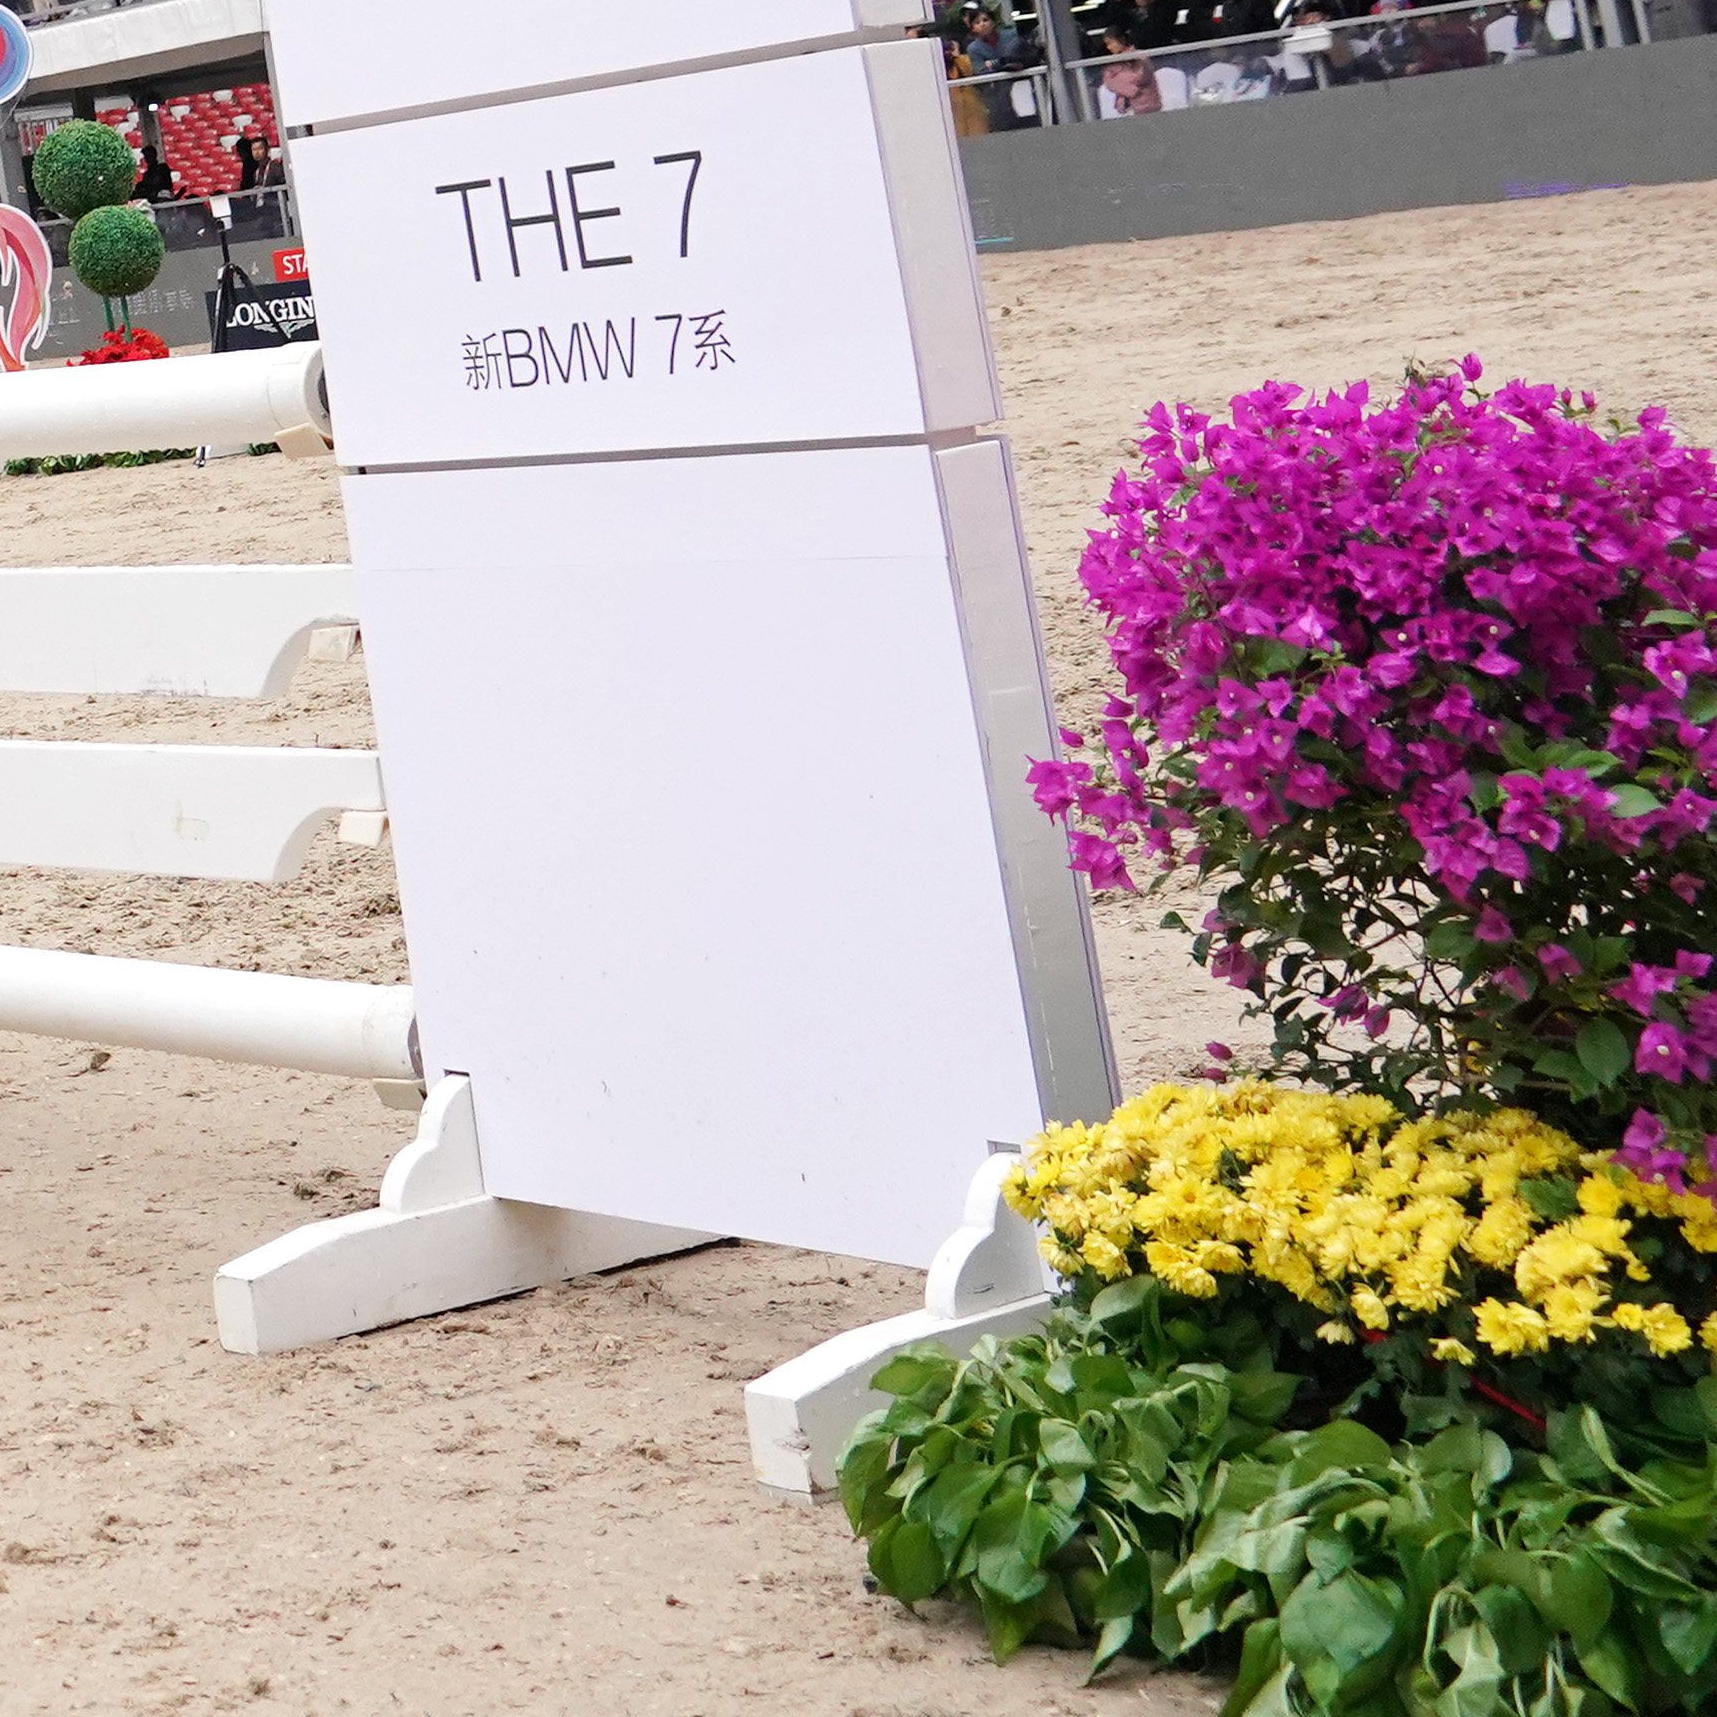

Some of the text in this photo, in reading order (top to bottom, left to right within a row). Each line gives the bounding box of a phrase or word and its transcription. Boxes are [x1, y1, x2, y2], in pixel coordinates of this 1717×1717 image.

[435, 150, 702, 282] THE 7
[227, 295, 315, 328] ONGIN
[461, 309, 736, 390] 新BMW 7系
